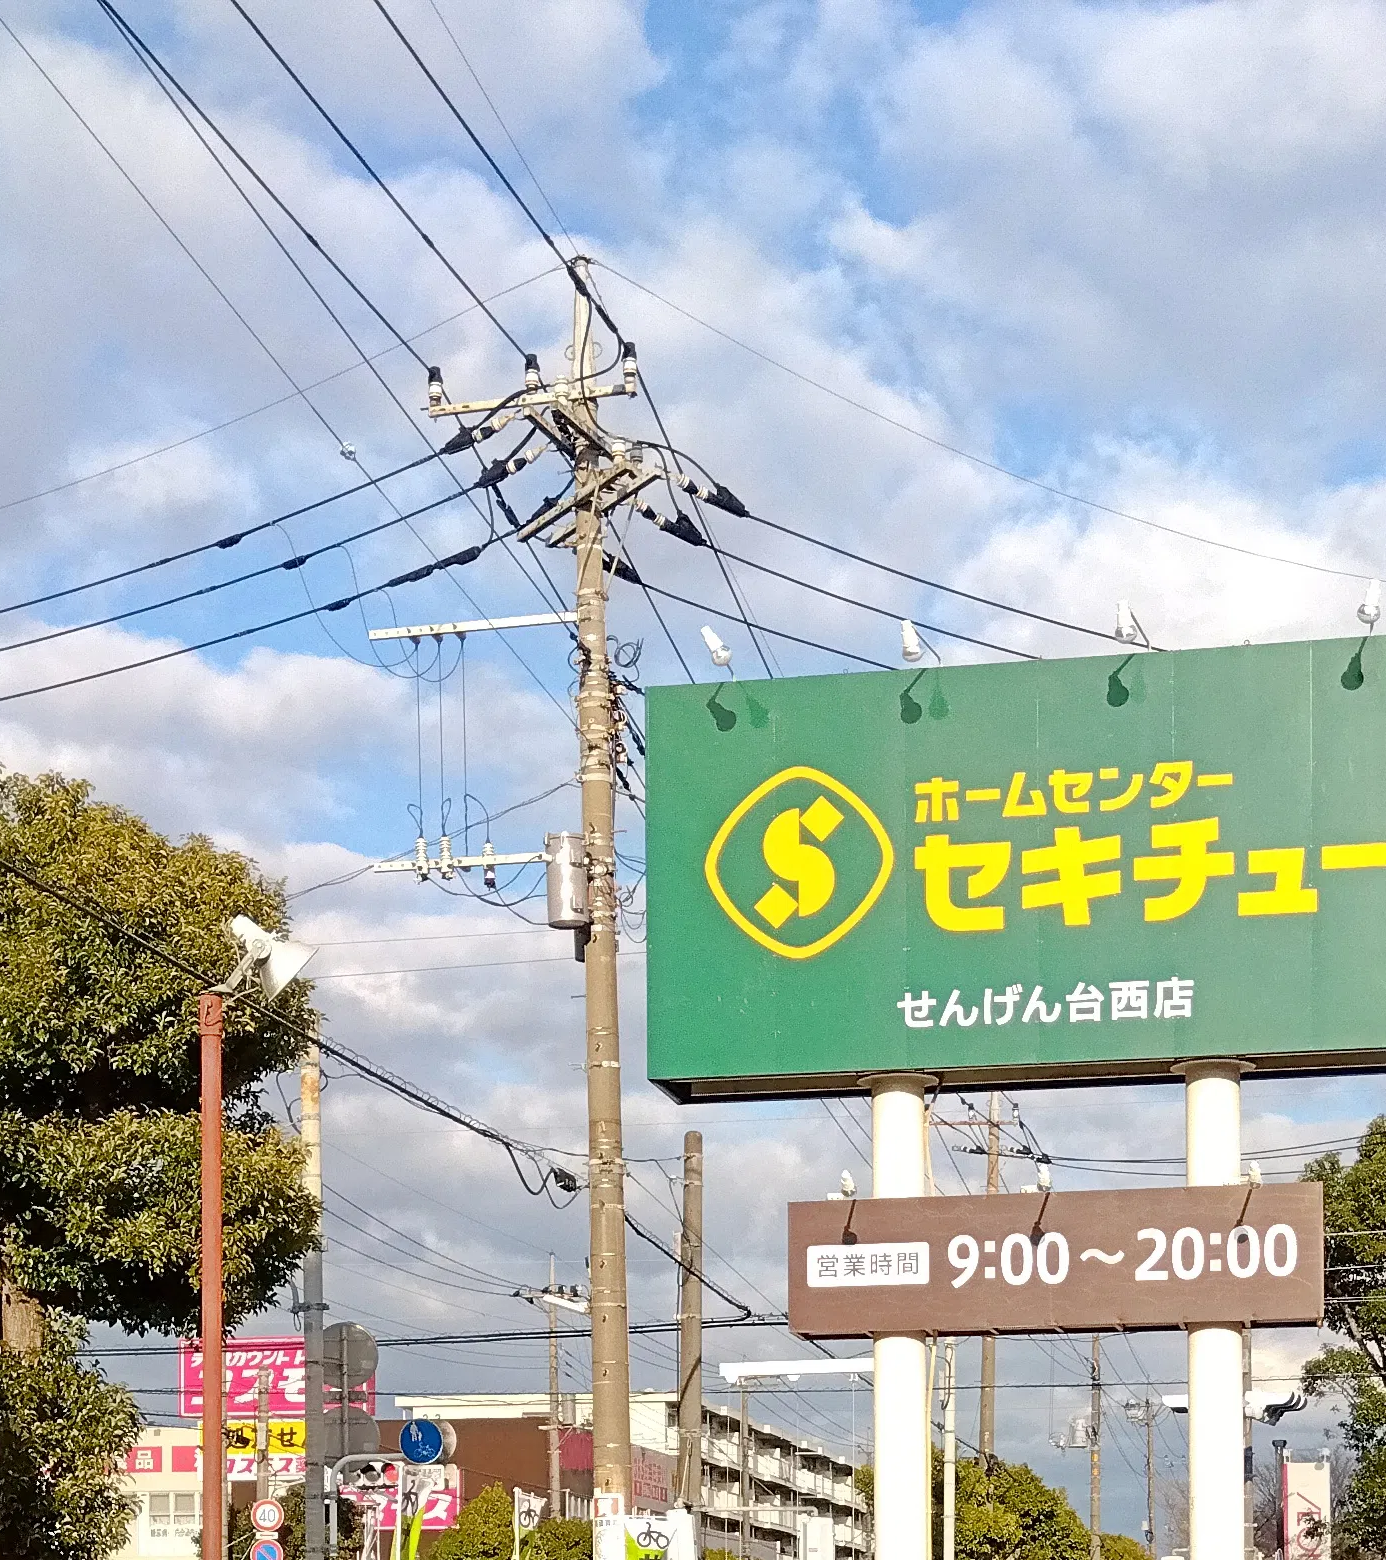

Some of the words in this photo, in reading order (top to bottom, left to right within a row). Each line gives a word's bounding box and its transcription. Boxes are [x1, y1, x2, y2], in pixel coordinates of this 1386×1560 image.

[914, 761, 1235, 824] ホームセンター
[897, 977, 1195, 1029] せんげん台西店
[817, 1251, 920, 1280] 営業時間
[259, 1509, 276, 1523] 40
